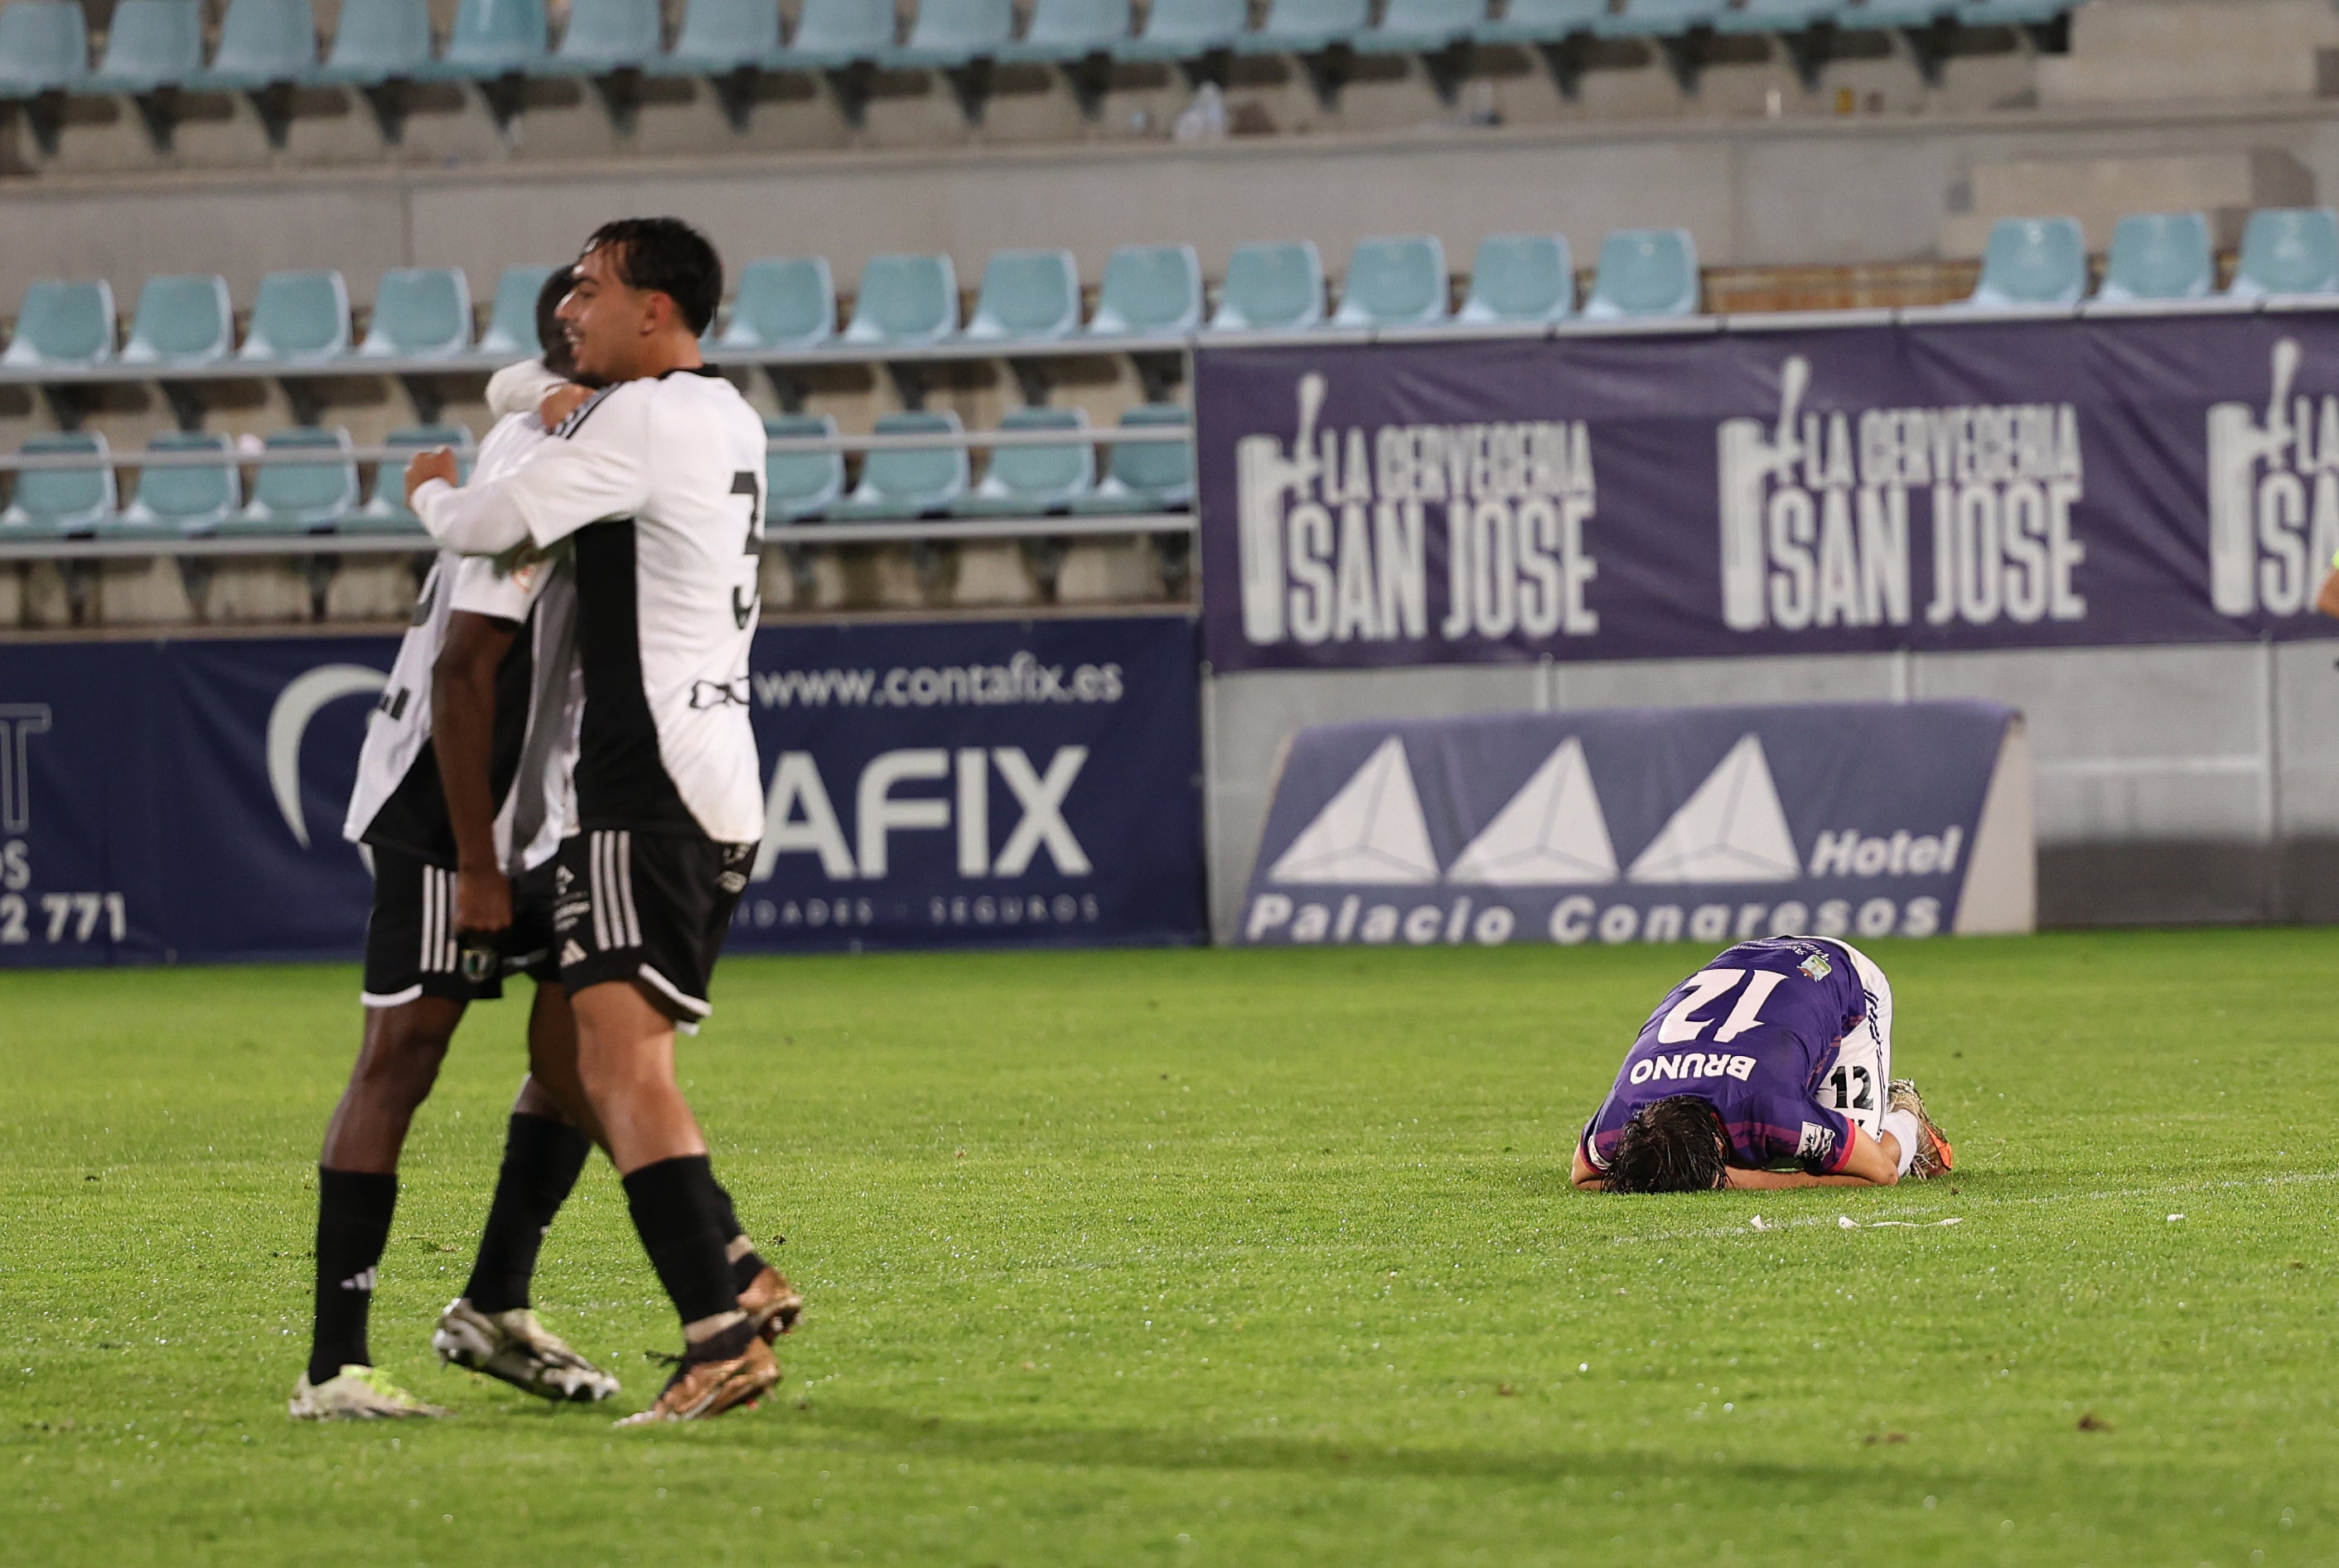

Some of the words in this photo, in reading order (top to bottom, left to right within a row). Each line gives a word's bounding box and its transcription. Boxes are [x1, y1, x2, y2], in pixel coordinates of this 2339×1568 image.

[1323, 427, 1372, 505] LA
[1376, 420, 1597, 499] CERVECERIA
[1805, 410, 1855, 490] LA
[1858, 403, 2083, 484] CERVECERIA
[1288, 500, 1427, 643] SAN
[1442, 496, 1600, 641] JOSE
[1768, 487, 1911, 630] SAN
[1926, 480, 2087, 625] JOSE
[752, 650, 1124, 710] www.contafix.es
[749, 746, 1093, 880] AFIX
[1807, 825, 1963, 879] Hotel
[40, 890, 127, 944] 771
[1244, 893, 1515, 945] Palacio
[1548, 895, 1941, 943] Congresos
[1658, 968, 1790, 1044] 12
[1631, 1053, 1757, 1084] BRUNO
[1830, 1065, 1874, 1111] 12
